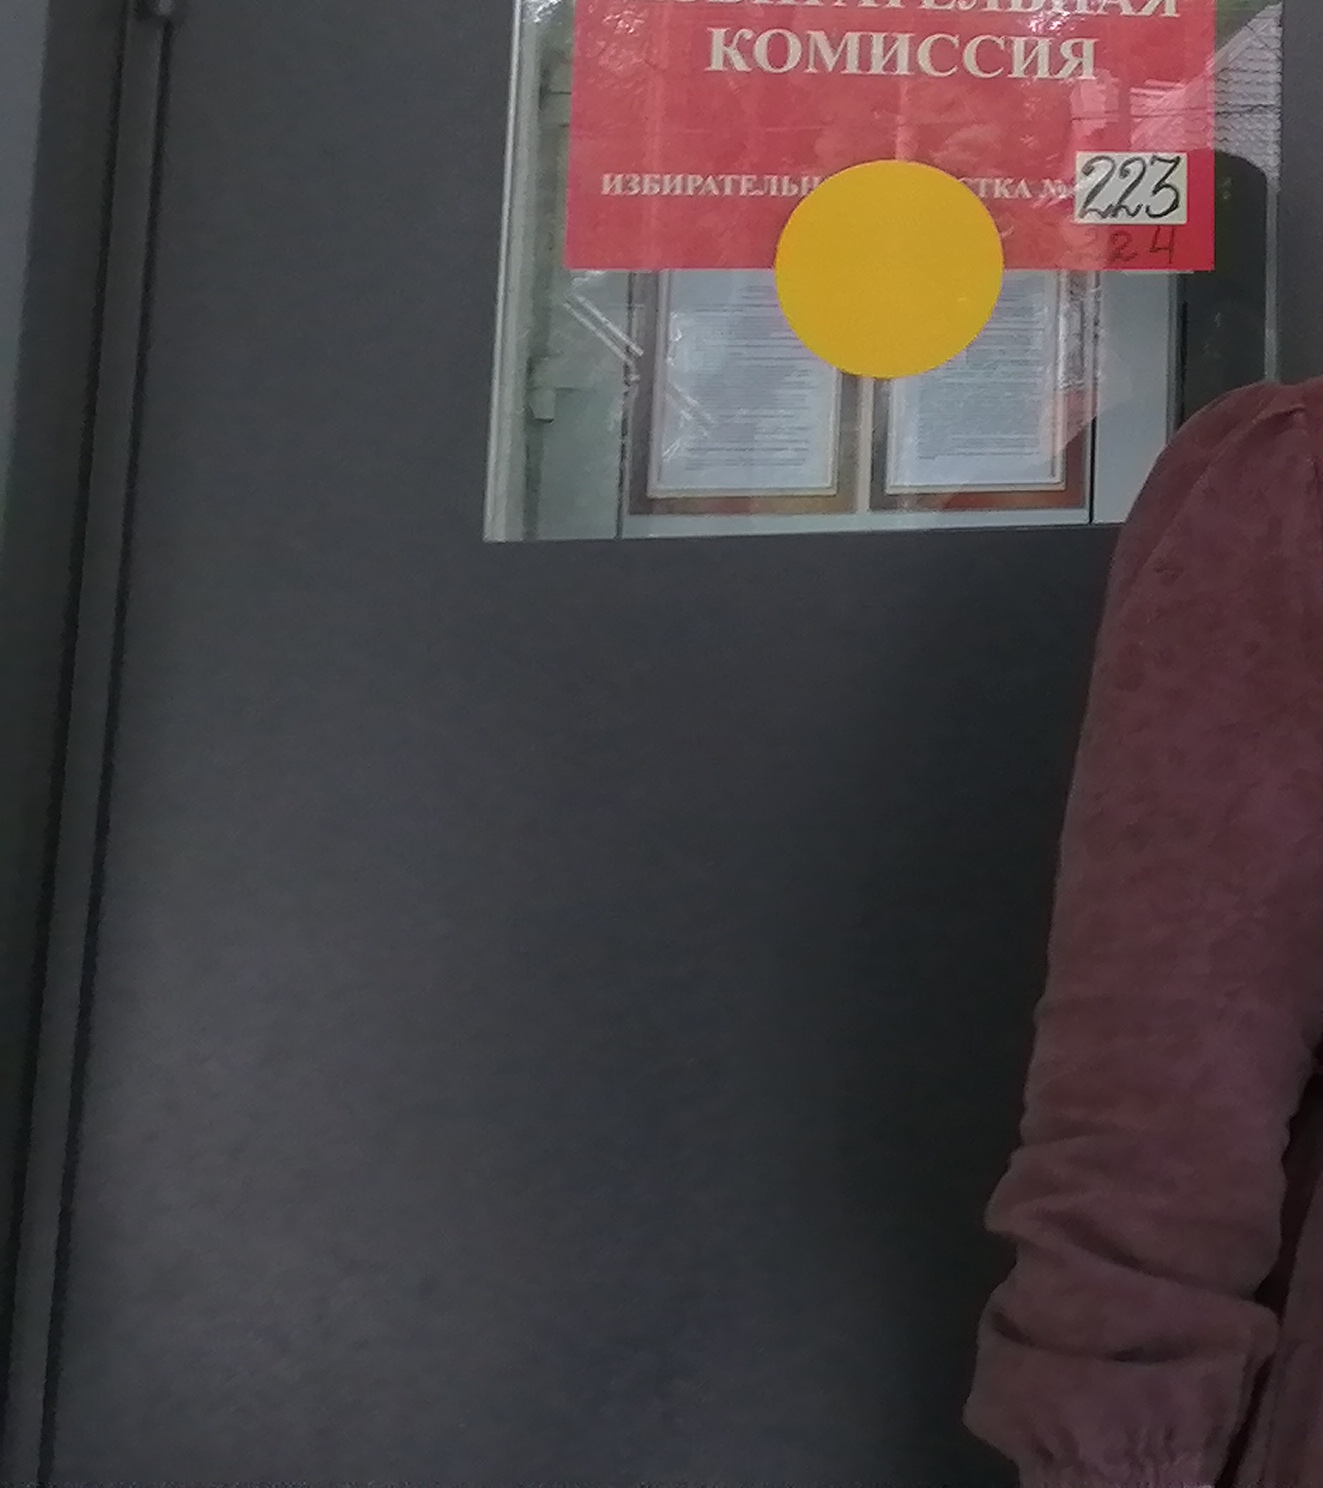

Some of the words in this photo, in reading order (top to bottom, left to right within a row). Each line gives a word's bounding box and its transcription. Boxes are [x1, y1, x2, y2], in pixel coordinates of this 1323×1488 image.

[706, 27, 1098, 81] КОМИССИЯ
[601, 172, 826, 197] ИЗБИРАТЕЛЬН
[1078, 155, 1181, 219] 223
